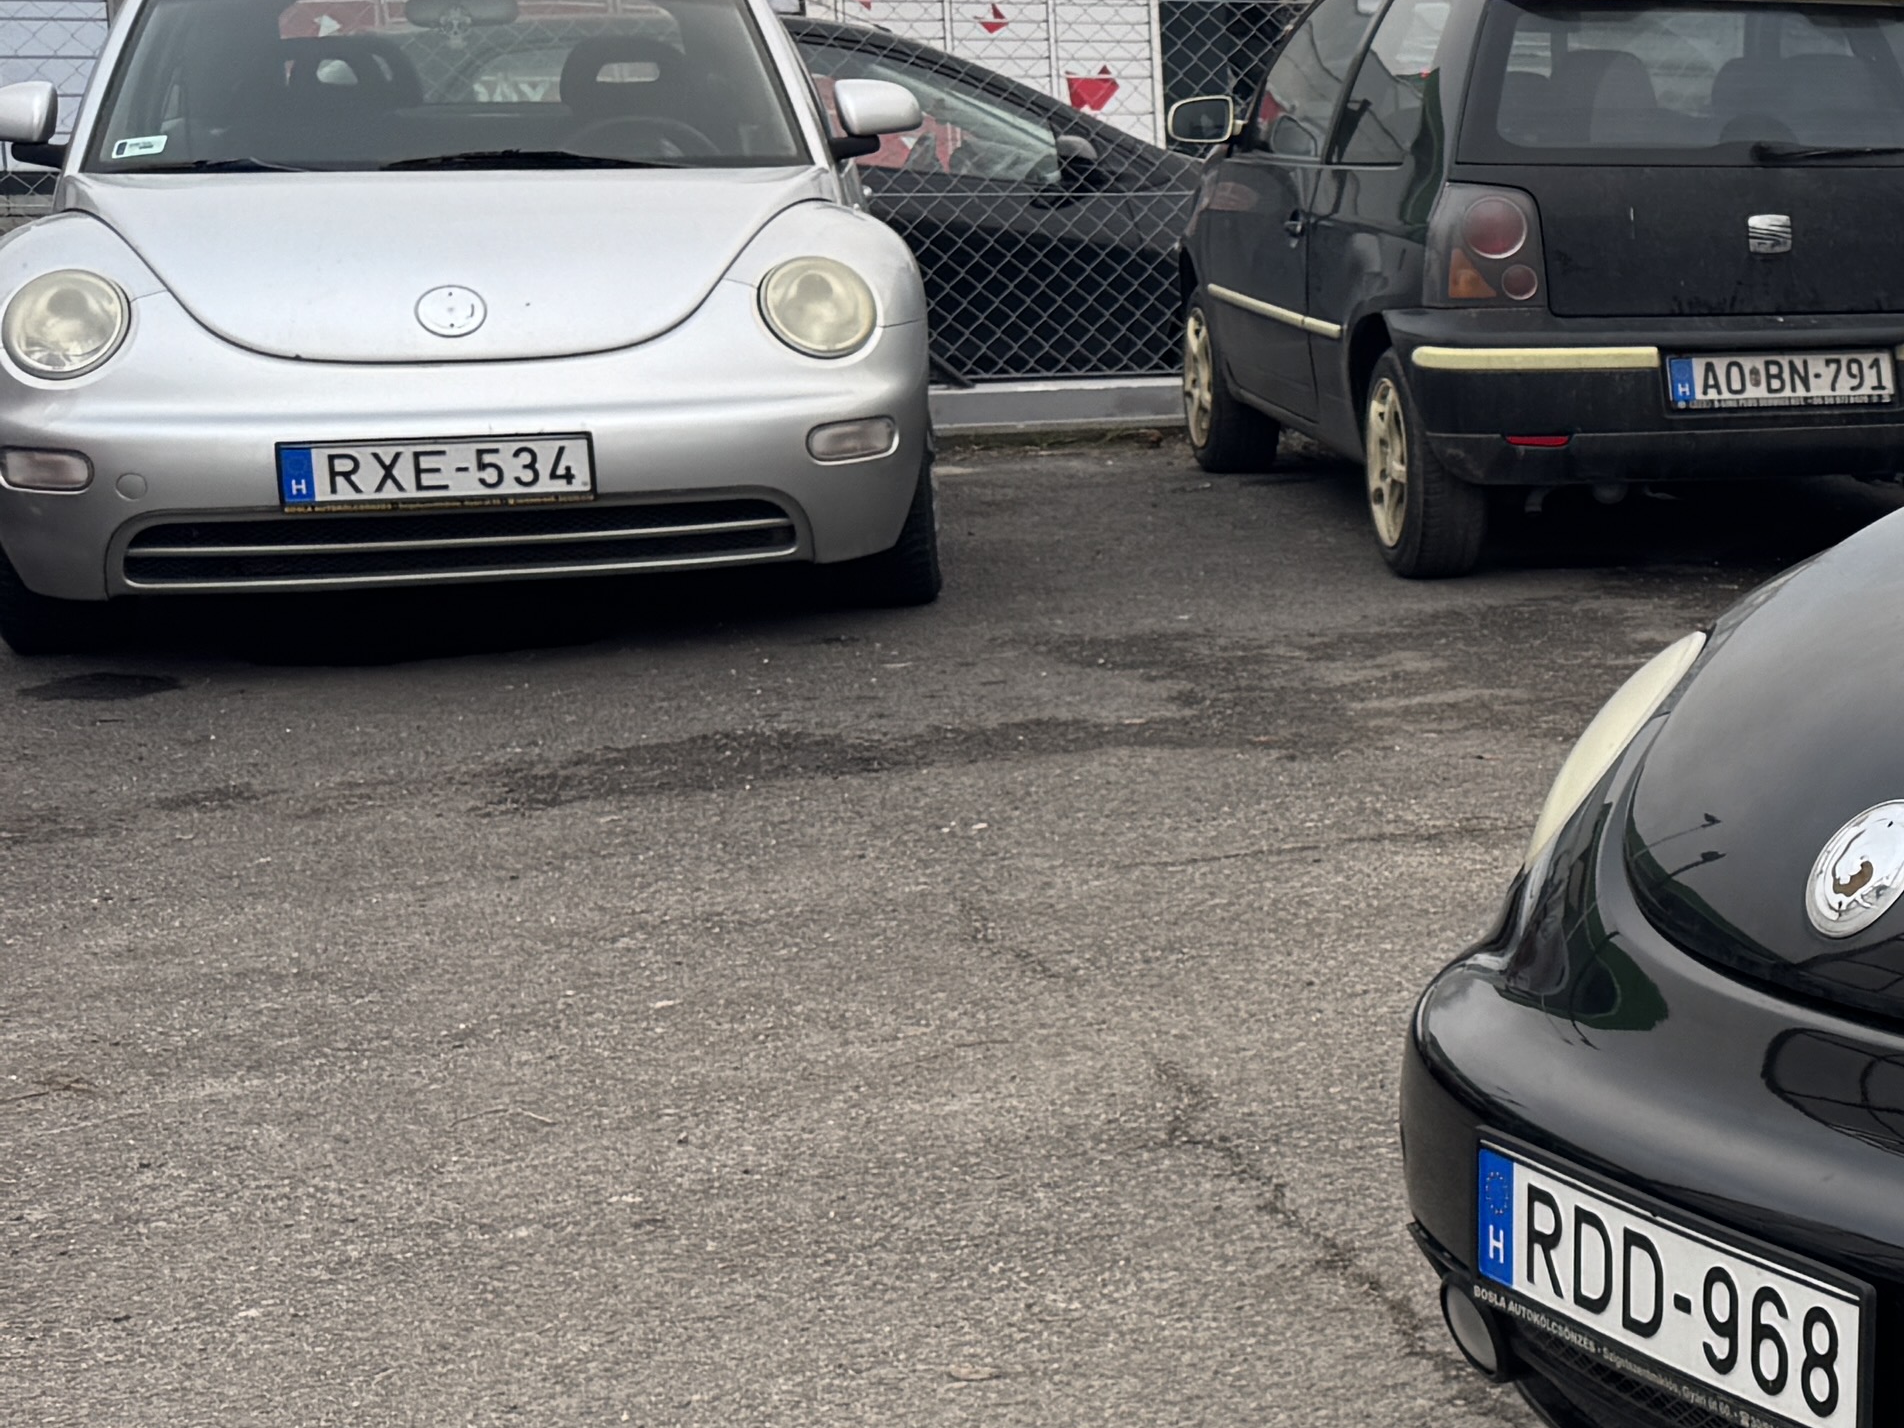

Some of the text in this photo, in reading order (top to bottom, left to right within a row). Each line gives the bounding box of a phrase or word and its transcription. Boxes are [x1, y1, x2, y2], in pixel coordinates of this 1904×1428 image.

[1677, 383, 1690, 396] H
[1702, 357, 1888, 396] AO BN-791
[291, 479, 306, 495] H
[326, 445, 576, 495] RXE-534
[1489, 1225, 1504, 1264] H
[1473, 1285, 1506, 1310] BOSLA
[1526, 1182, 1840, 1419] RDD-968
